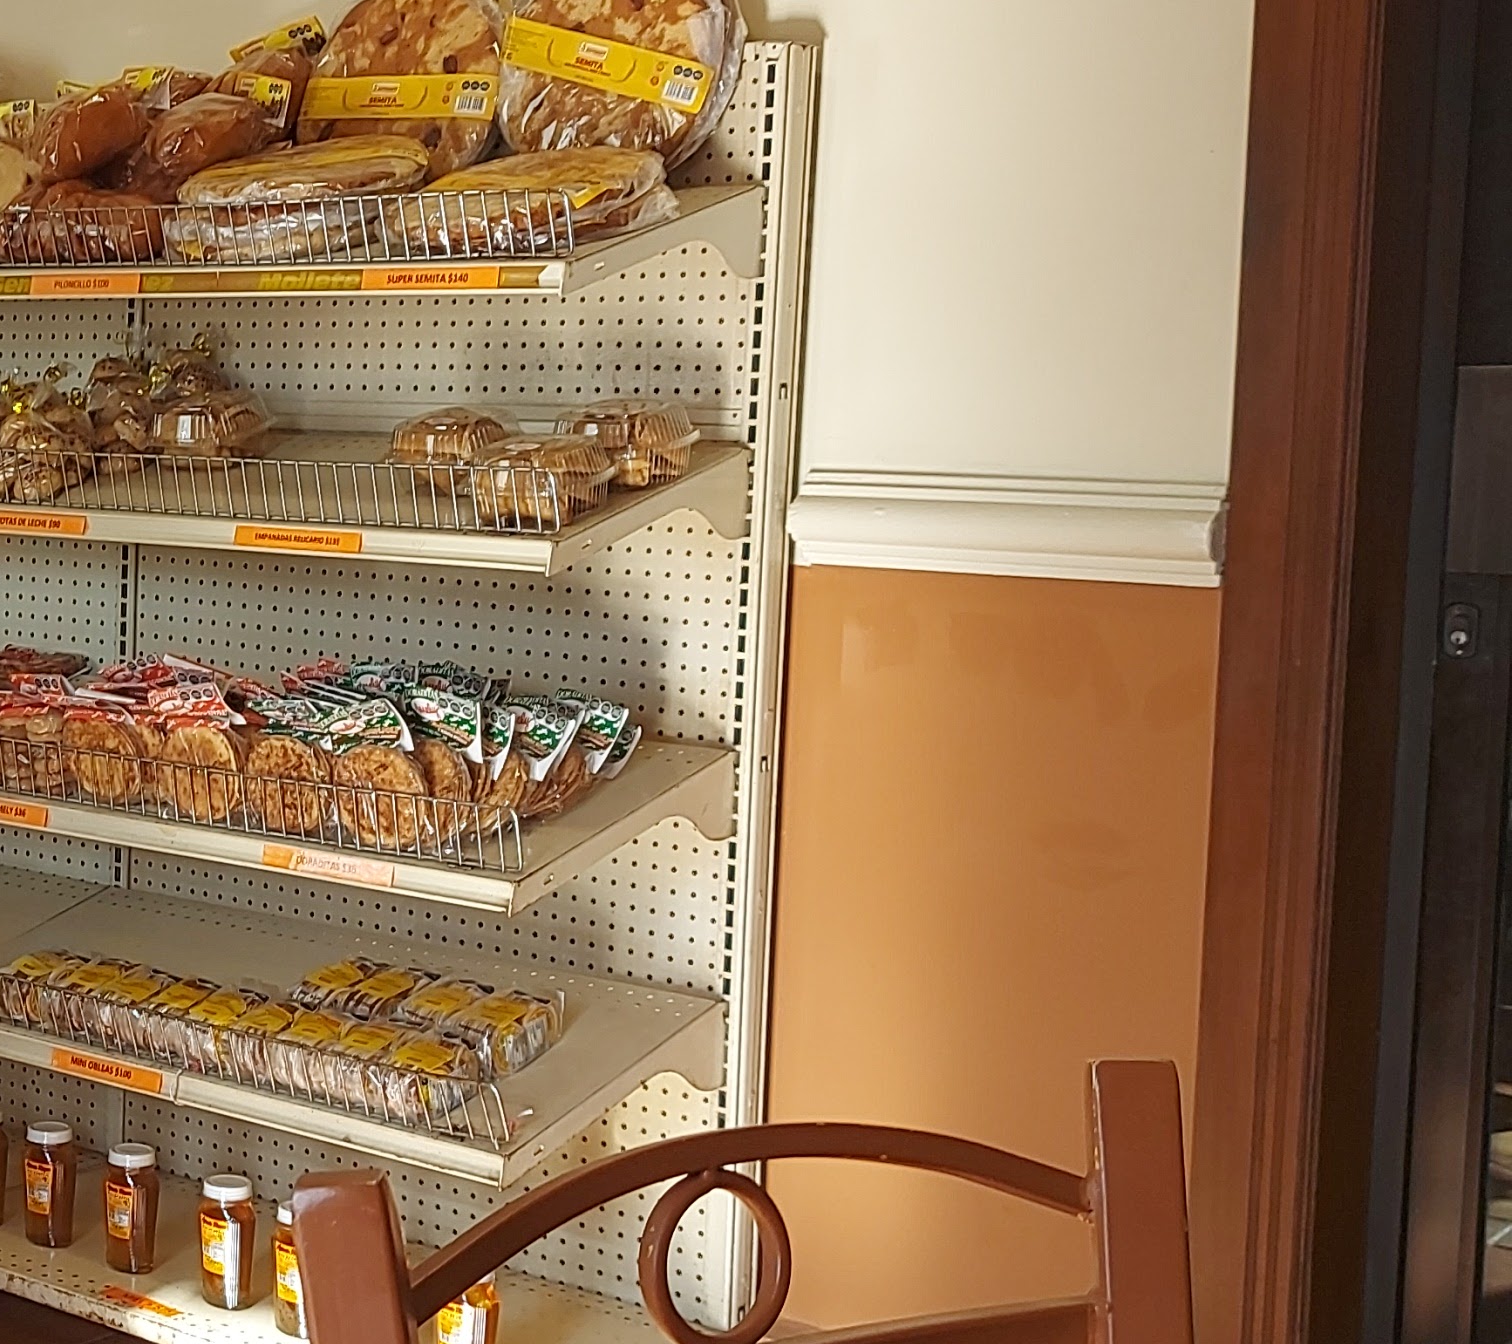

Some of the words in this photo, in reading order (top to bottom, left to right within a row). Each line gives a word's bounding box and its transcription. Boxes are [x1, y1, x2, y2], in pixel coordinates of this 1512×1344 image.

[386, 273, 414, 285] SUPER
[414, 272, 446, 284] SEMITA
[447, 271, 469, 284] $140
[17, 517, 26, 526] DE
[27, 518, 47, 528] LECHE
[254, 532, 292, 543] EMPANADAS
[295, 854, 340, 872] DORADITAS
[70, 1055, 87, 1069] MINI
[87, 1060, 114, 1076] OBLEAS
